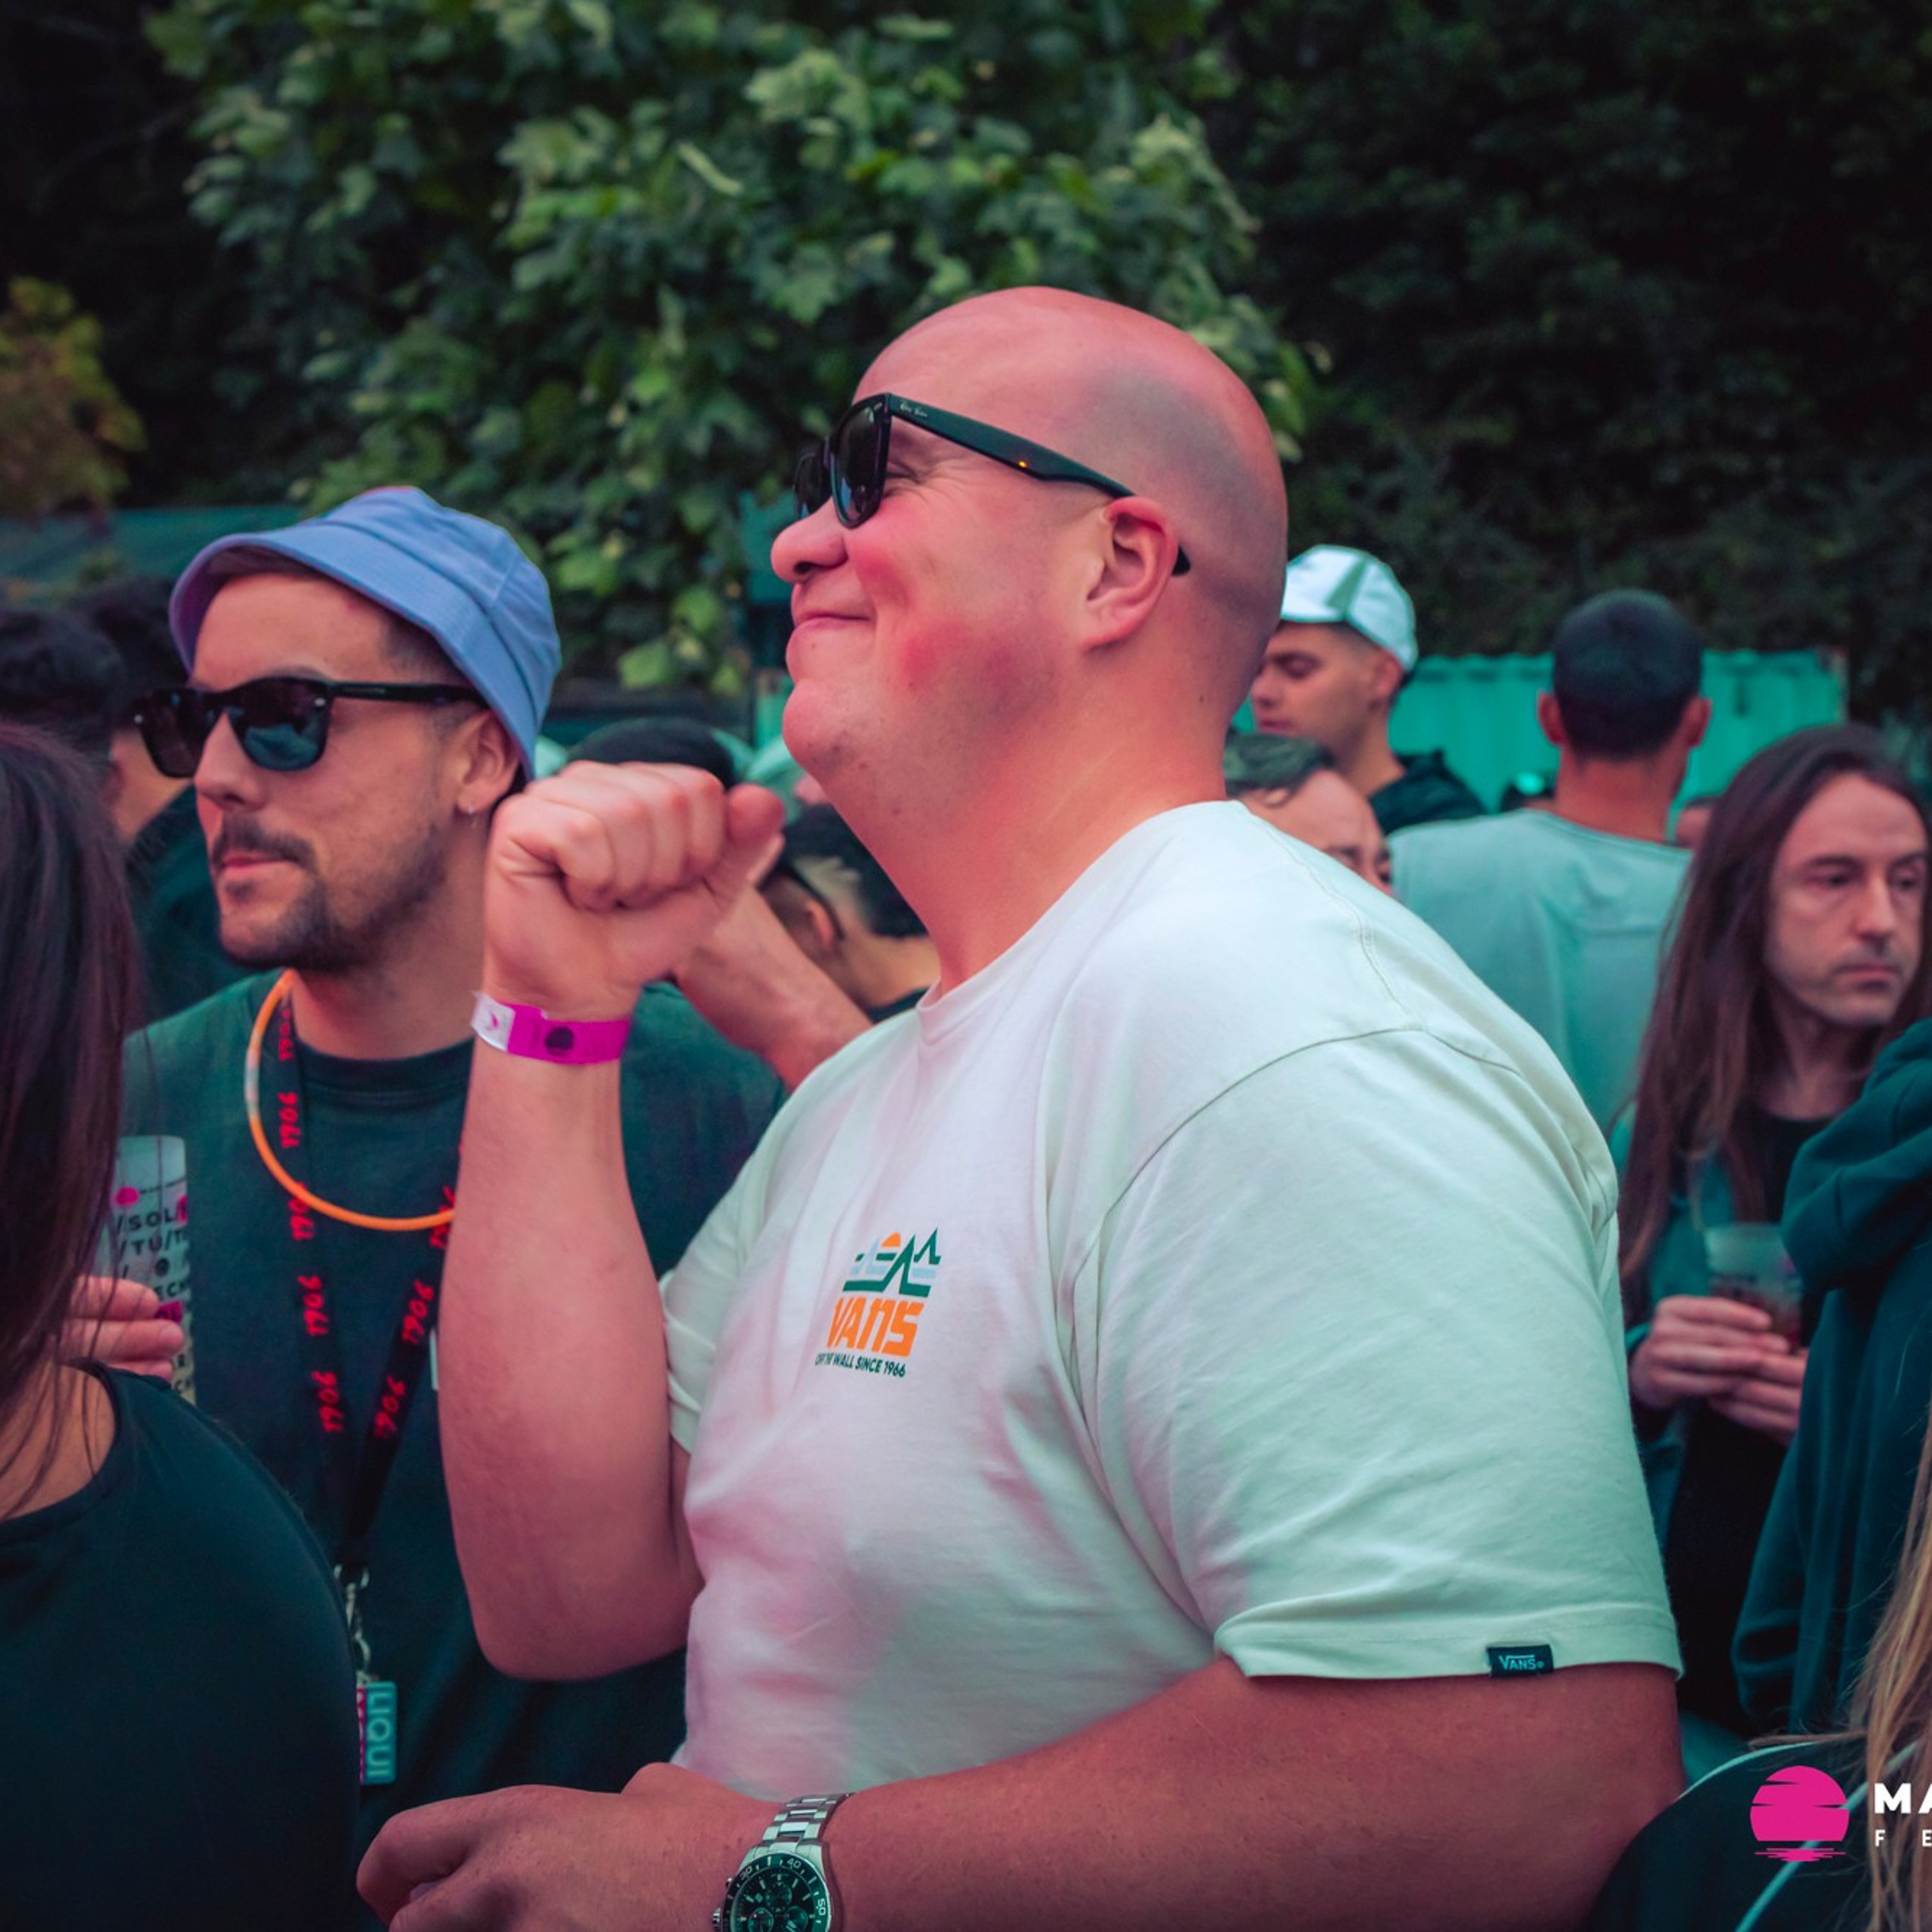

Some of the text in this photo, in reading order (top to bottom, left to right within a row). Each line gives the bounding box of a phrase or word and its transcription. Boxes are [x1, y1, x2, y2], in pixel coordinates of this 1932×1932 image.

[277, 1092, 300, 1148] 1906
[288, 1183, 314, 1240] 190
[298, 1275, 328, 1336] 1906
[401, 1278, 434, 1344] 1906
[826, 1297, 924, 1357] VANS
[833, 1354, 854, 1368] WALL
[855, 1356, 883, 1374] SINCE
[883, 1361, 906, 1377] 1966
[312, 1370, 344, 1433] 1906
[374, 1375, 406, 1438] 1906
[1498, 1654, 1537, 1671] VANS
[787, 1858, 801, 1869] 40
[817, 1899, 826, 1915] 50
